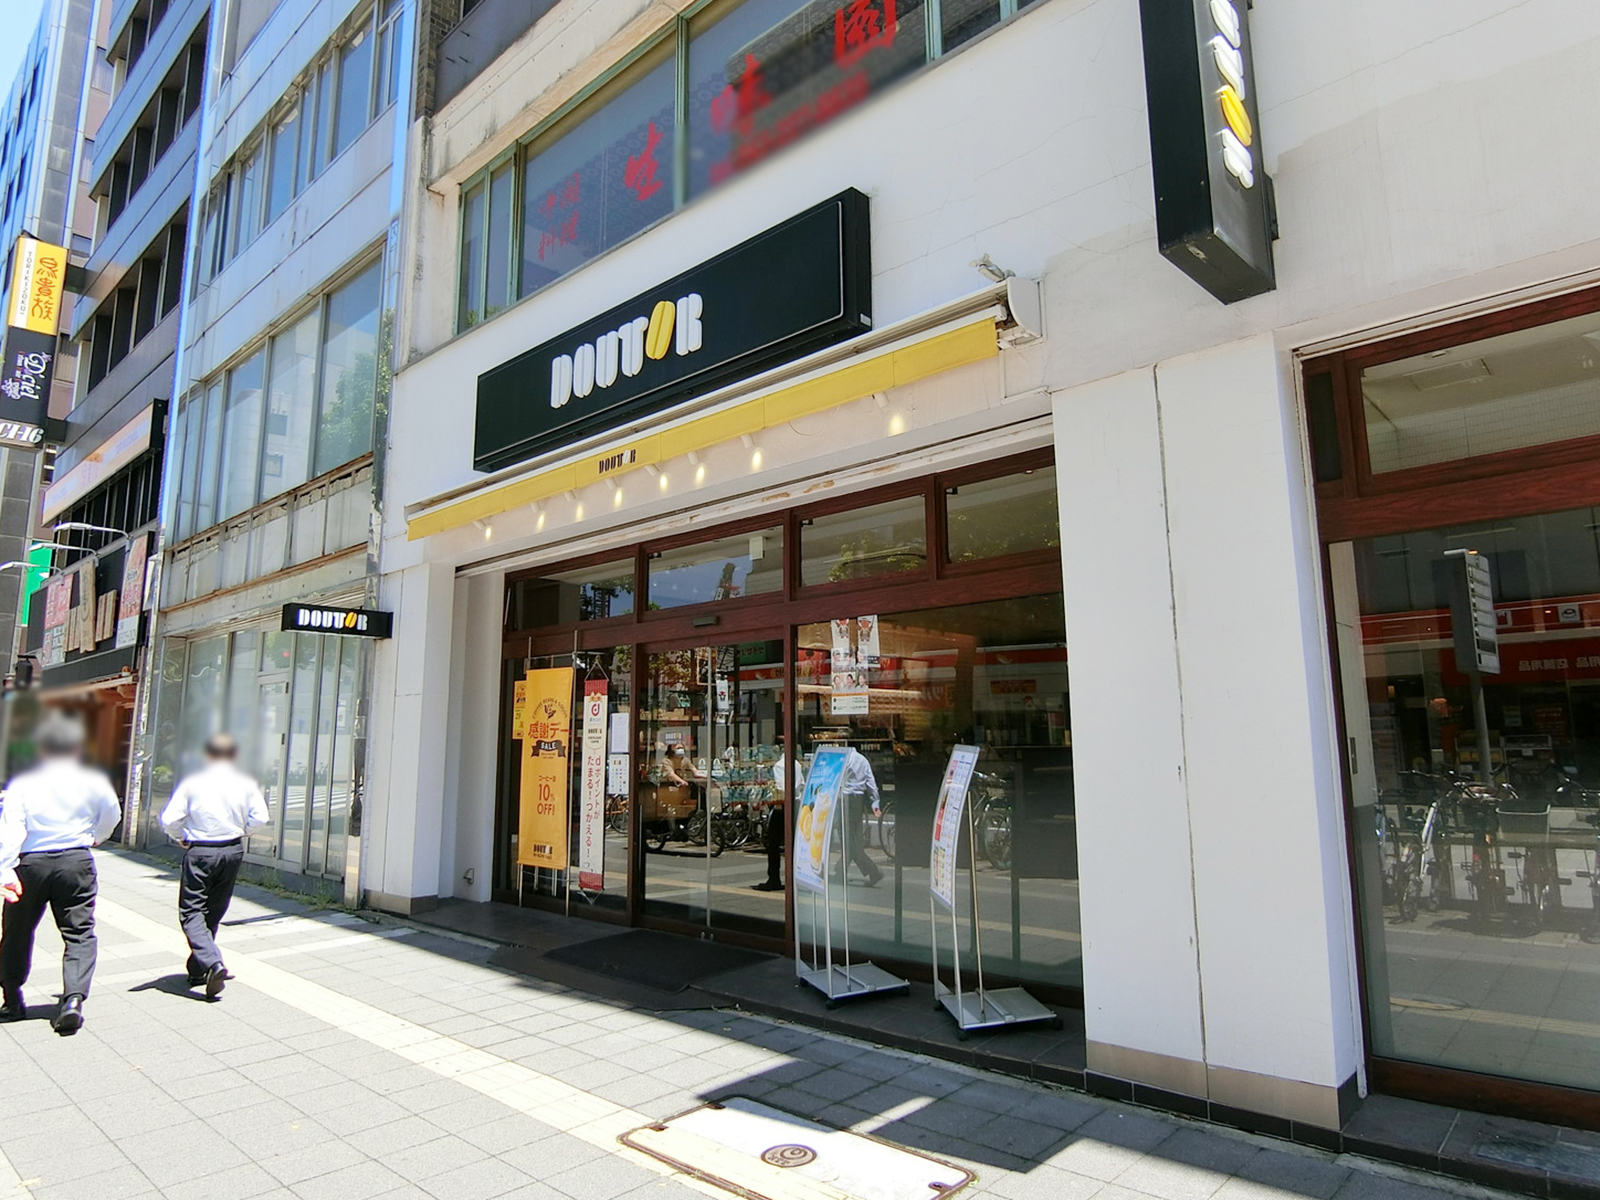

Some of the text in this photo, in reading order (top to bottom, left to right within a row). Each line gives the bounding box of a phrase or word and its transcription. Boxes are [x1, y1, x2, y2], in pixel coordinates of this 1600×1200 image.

[550, 292, 704, 409] DOUTOR
[598, 449, 636, 474] DOUTOR
[298, 608, 368, 631] DOUTOR
[528, 720, 569, 740] 感謝デー
[541, 742, 556, 750] SALE
[537, 804, 556, 816] OFF!
